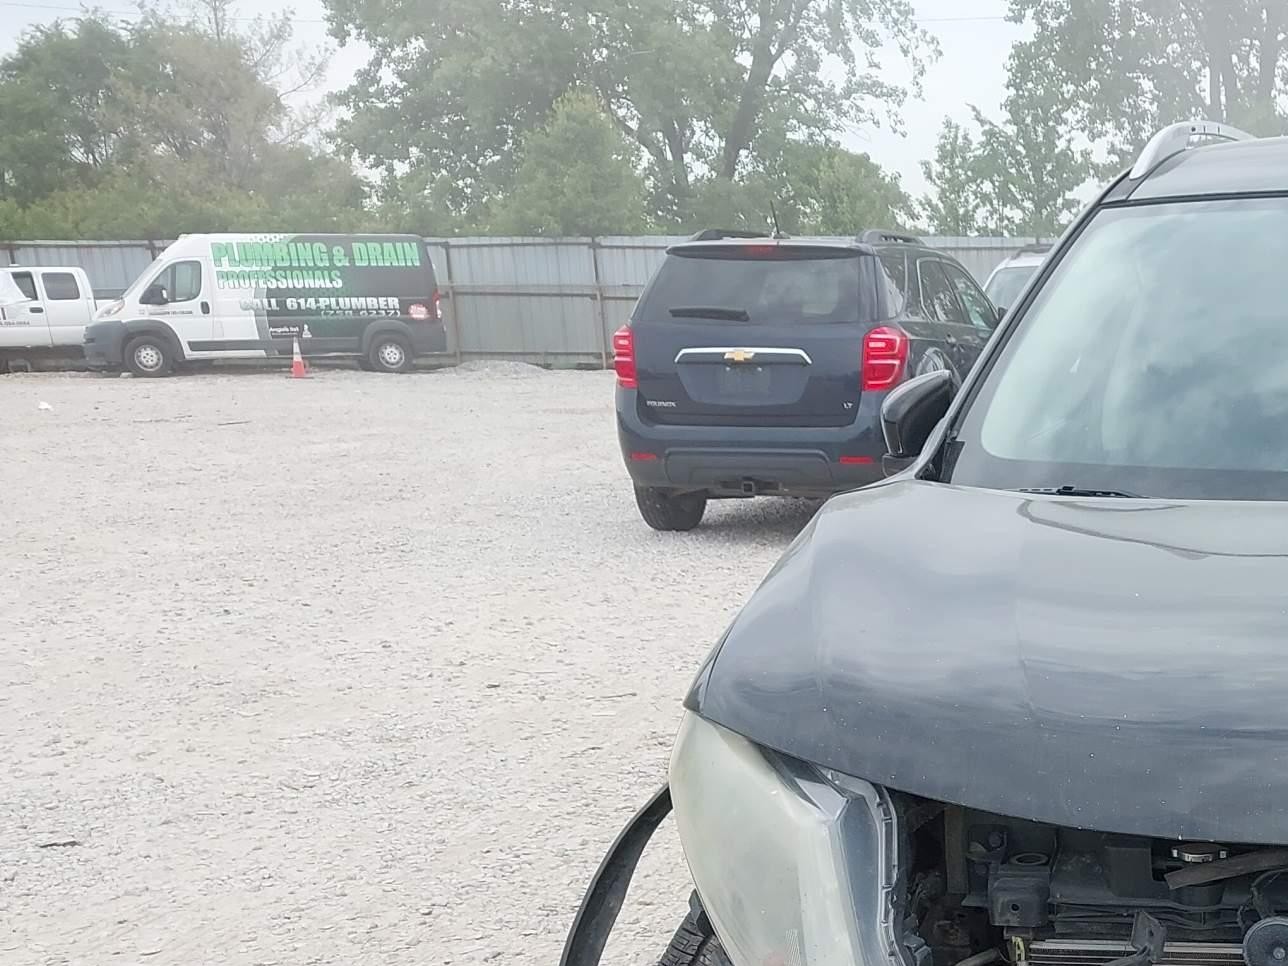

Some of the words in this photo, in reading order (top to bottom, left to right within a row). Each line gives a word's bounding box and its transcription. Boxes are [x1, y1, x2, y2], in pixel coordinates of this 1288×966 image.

[211, 242, 329, 267] PLUMBING
[332, 246, 350, 267] &
[352, 242, 420, 267] DRAIN
[216, 270, 343, 289] PROFESSIONALS
[240, 297, 280, 311] CALL
[286, 296, 400, 310] 614-PLUMBER
